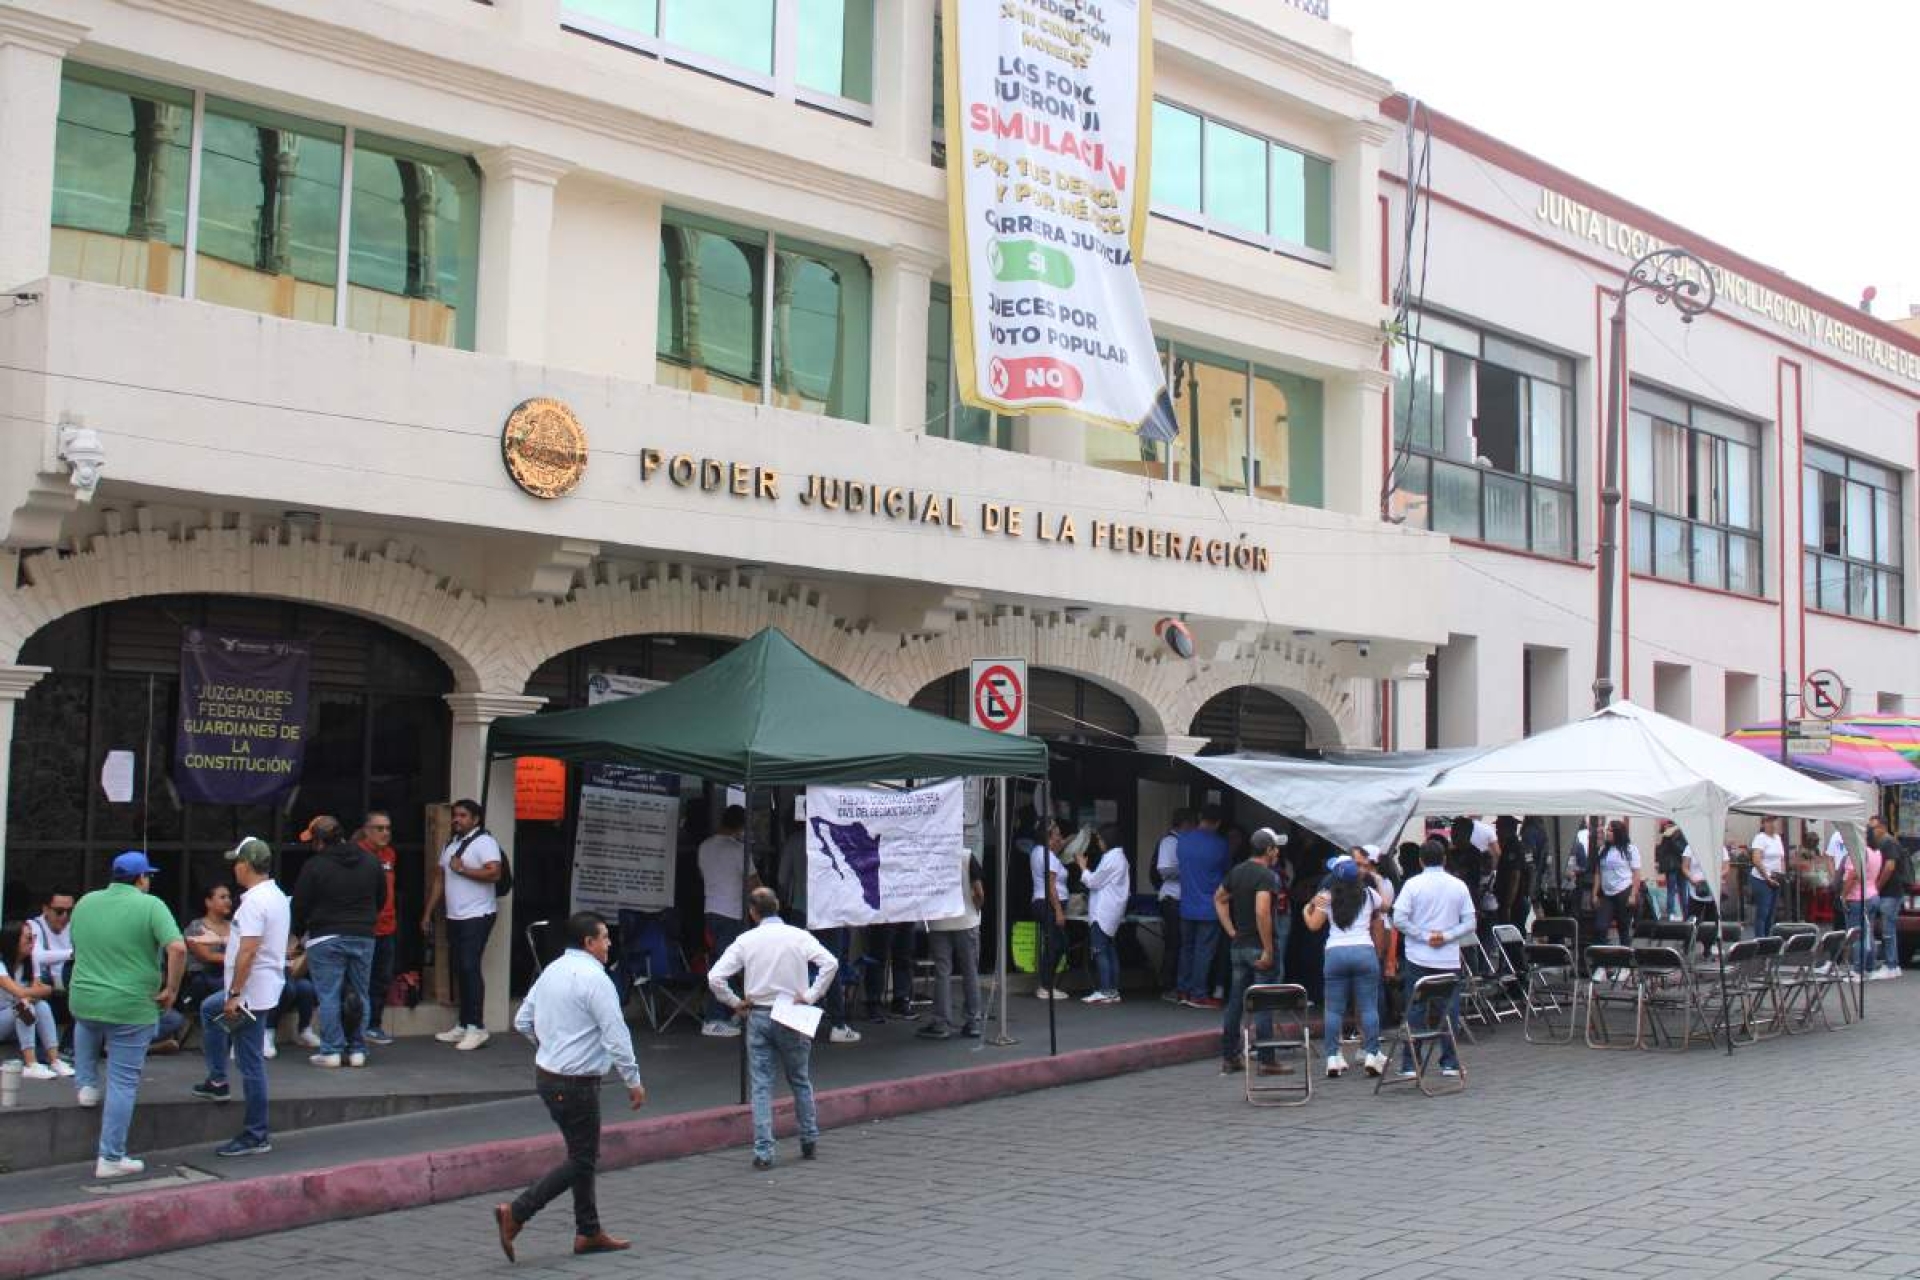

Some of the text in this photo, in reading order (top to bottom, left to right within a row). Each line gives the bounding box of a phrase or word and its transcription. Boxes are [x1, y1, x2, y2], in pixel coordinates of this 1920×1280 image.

[998, 55, 1040, 84] LOS
[1536, 188, 1601, 243] JUNTA
[1809, 308, 1823, 339] Y
[1822, 317, 1899, 372] ARBITRAJE
[1059, 304, 1098, 331] POR
[1047, 327, 1128, 366] POPULAR
[1024, 367, 1063, 388] NO
[640, 447, 780, 500] PODER
[800, 473, 964, 528] JUDICIAL
[981, 503, 1024, 537] DE
[1037, 511, 1077, 544] LA
[1091, 519, 1270, 573] FEDERACIÓN
[197, 684, 294, 705] JUZGADORES
[199, 702, 283, 721] FEDERALES
[183, 720, 301, 740] GUARDIANES DE
[231, 740, 251, 753] LA
[185, 754, 293, 772] CONSTITUCIÓN
